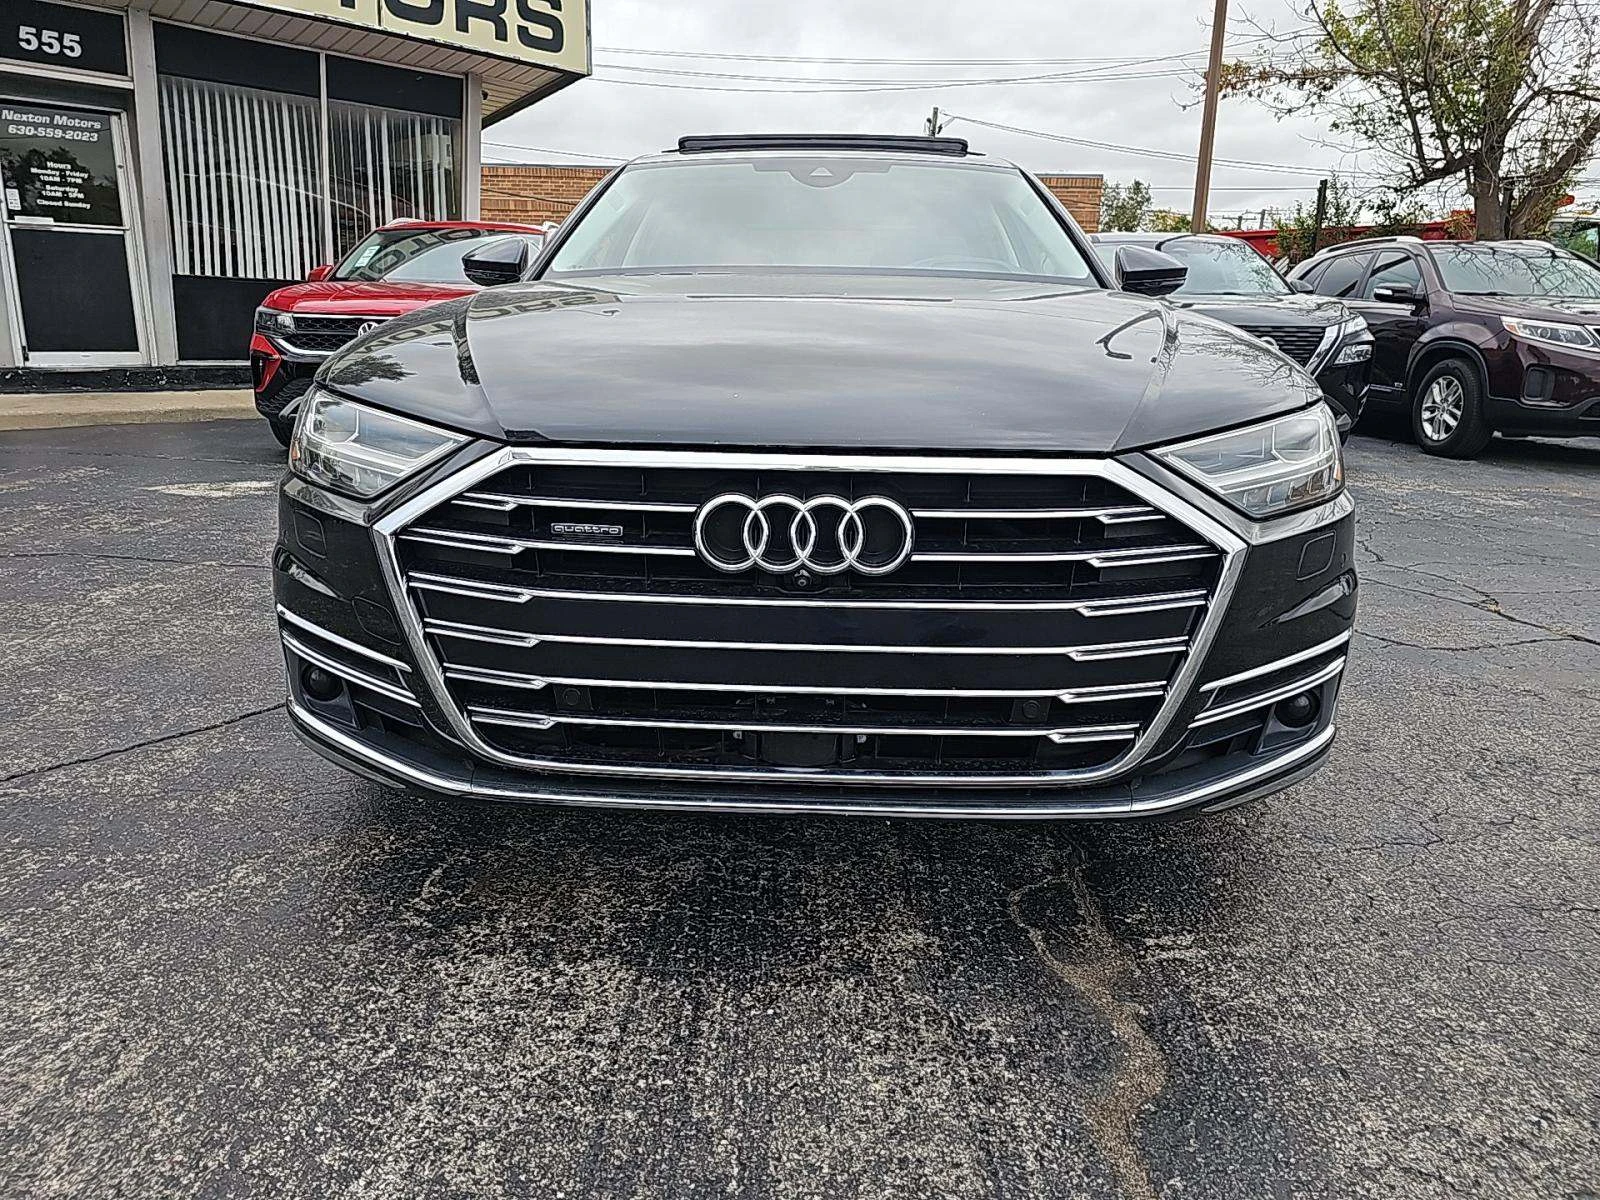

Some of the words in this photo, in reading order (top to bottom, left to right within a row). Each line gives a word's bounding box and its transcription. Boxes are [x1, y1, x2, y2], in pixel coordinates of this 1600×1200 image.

[341, 0, 564, 53] RS
[18, 25, 82, 57] 555
[1, 109, 50, 124] Nexton
[53, 115, 101, 129] Motors
[8, 124, 98, 141] 630-559-2023
[46, 161, 71, 169] Hours
[554, 525, 619, 534] quattro
